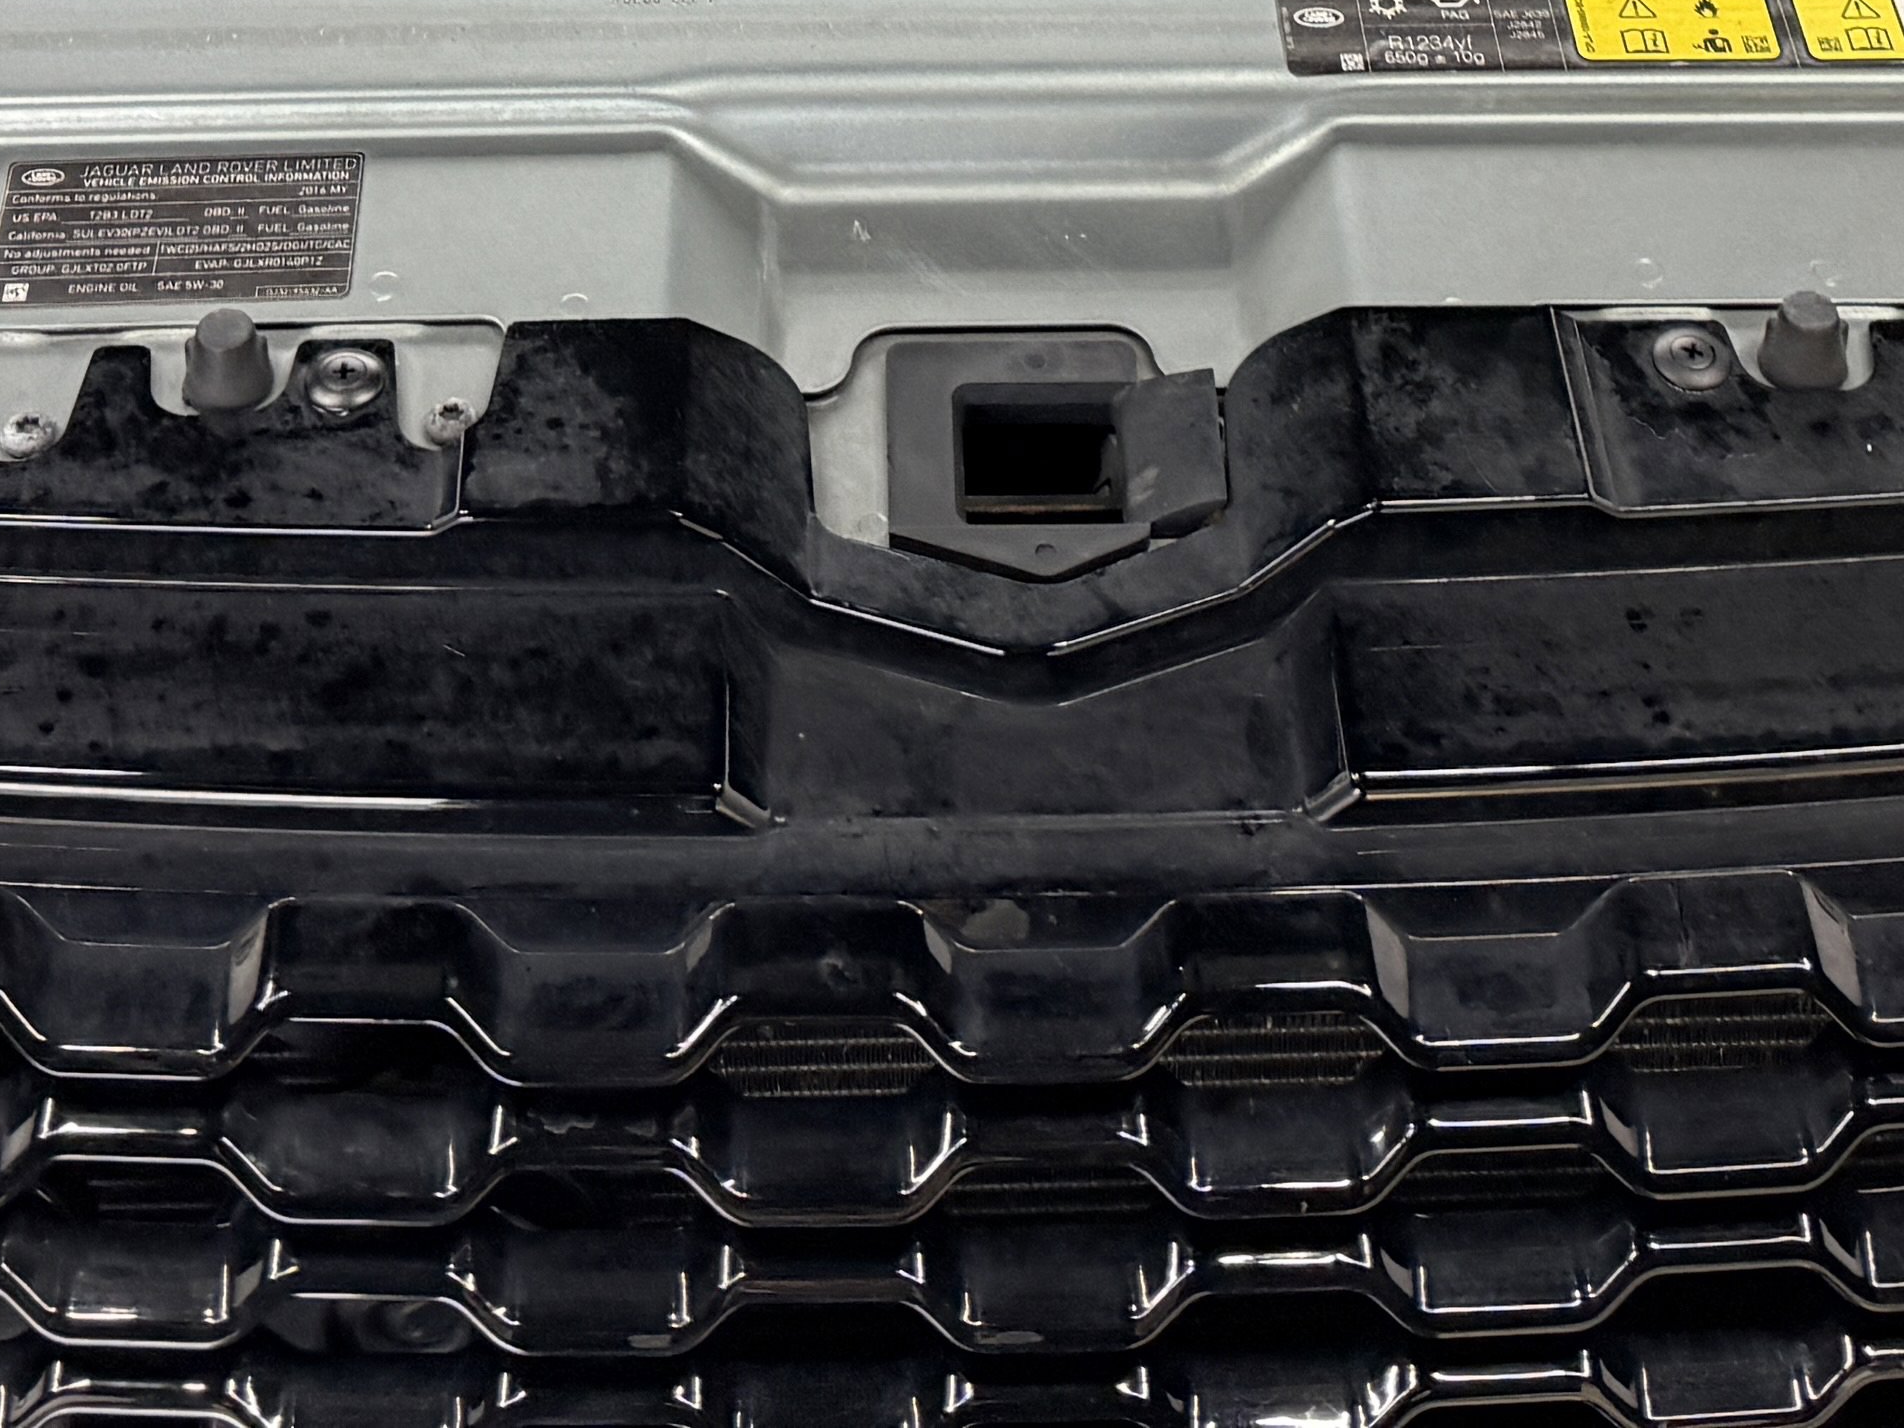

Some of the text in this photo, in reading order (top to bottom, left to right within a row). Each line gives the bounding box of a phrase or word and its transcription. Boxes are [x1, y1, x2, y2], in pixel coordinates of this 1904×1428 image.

[1440, 9, 1470, 20] PAG
[1387, 34, 1473, 52] R1234yf
[1384, 50, 1429, 67] 650g
[1453, 49, 1486, 66] 10g
[80, 157, 357, 178] JAGUAR LAND ROVER LIMITED
[83, 170, 350, 188] VEHICLE EMISSION CONTROL INFORMATION
[11, 192, 71, 205] Conforms
[74, 192, 86, 203] to
[297, 204, 351, 215] Gasoline
[12, 212, 30, 224] US
[296, 222, 350, 233] Gasoline
[7, 230, 67, 242] California
[3, 245, 150, 260] No adjustments needed
[67, 282, 116, 294] ENGINE
[118, 282, 139, 293] OIL
[184, 279, 225, 291] 5W-30
